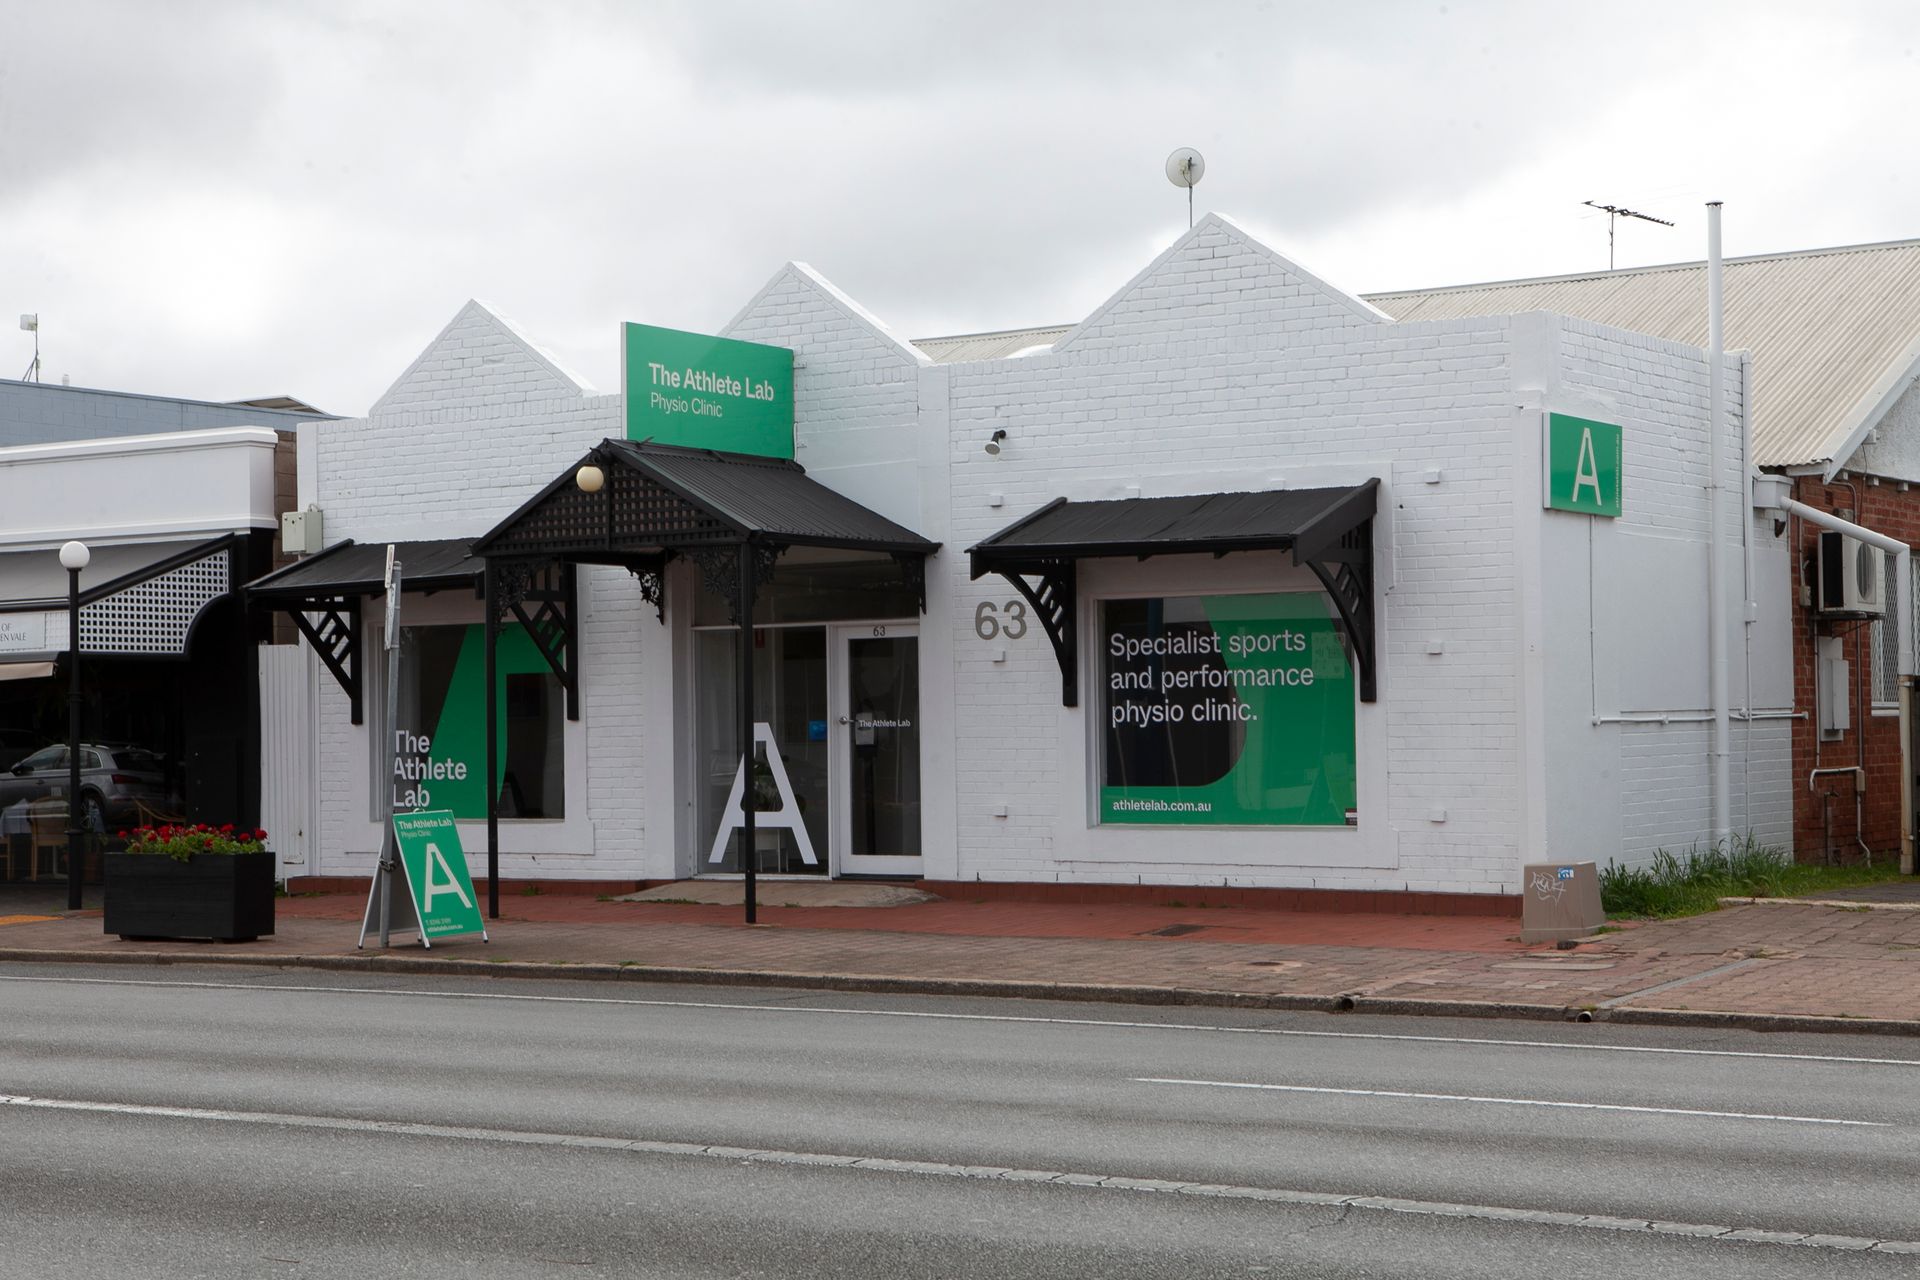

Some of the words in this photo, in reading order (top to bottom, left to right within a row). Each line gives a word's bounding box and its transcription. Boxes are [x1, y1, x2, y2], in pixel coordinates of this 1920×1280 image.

[649, 362, 680, 388] The
[683, 368, 742, 397] Athlete
[746, 377, 775, 401] Lab
[651, 392, 689, 414] Physio
[691, 397, 723, 418] Clinic
[1572, 428, 1602, 506] A
[873, 625, 886, 637] 63
[974, 599, 1027, 640] 63
[1110, 630, 1221, 662] Specialist
[1229, 629, 1306, 658] sports
[1111, 665, 1152, 690] and
[1162, 664, 1314, 694] performance
[859, 718, 871, 728] The
[873, 718, 896, 728] Athlete
[897, 718, 911, 728] Lab
[1112, 698, 1184, 728] physio
[1191, 697, 1258, 722] clinic.
[395, 729, 430, 754] The
[393, 756, 467, 781] Athlete
[392, 783, 430, 808] Lab
[708, 721, 818, 865] A
[1112, 799, 1212, 812] athletelab.com.au
[398, 820, 413, 830] The
[414, 818, 438, 829] Athlete
[438, 817, 452, 827] Lab
[424, 842, 473, 913] A
